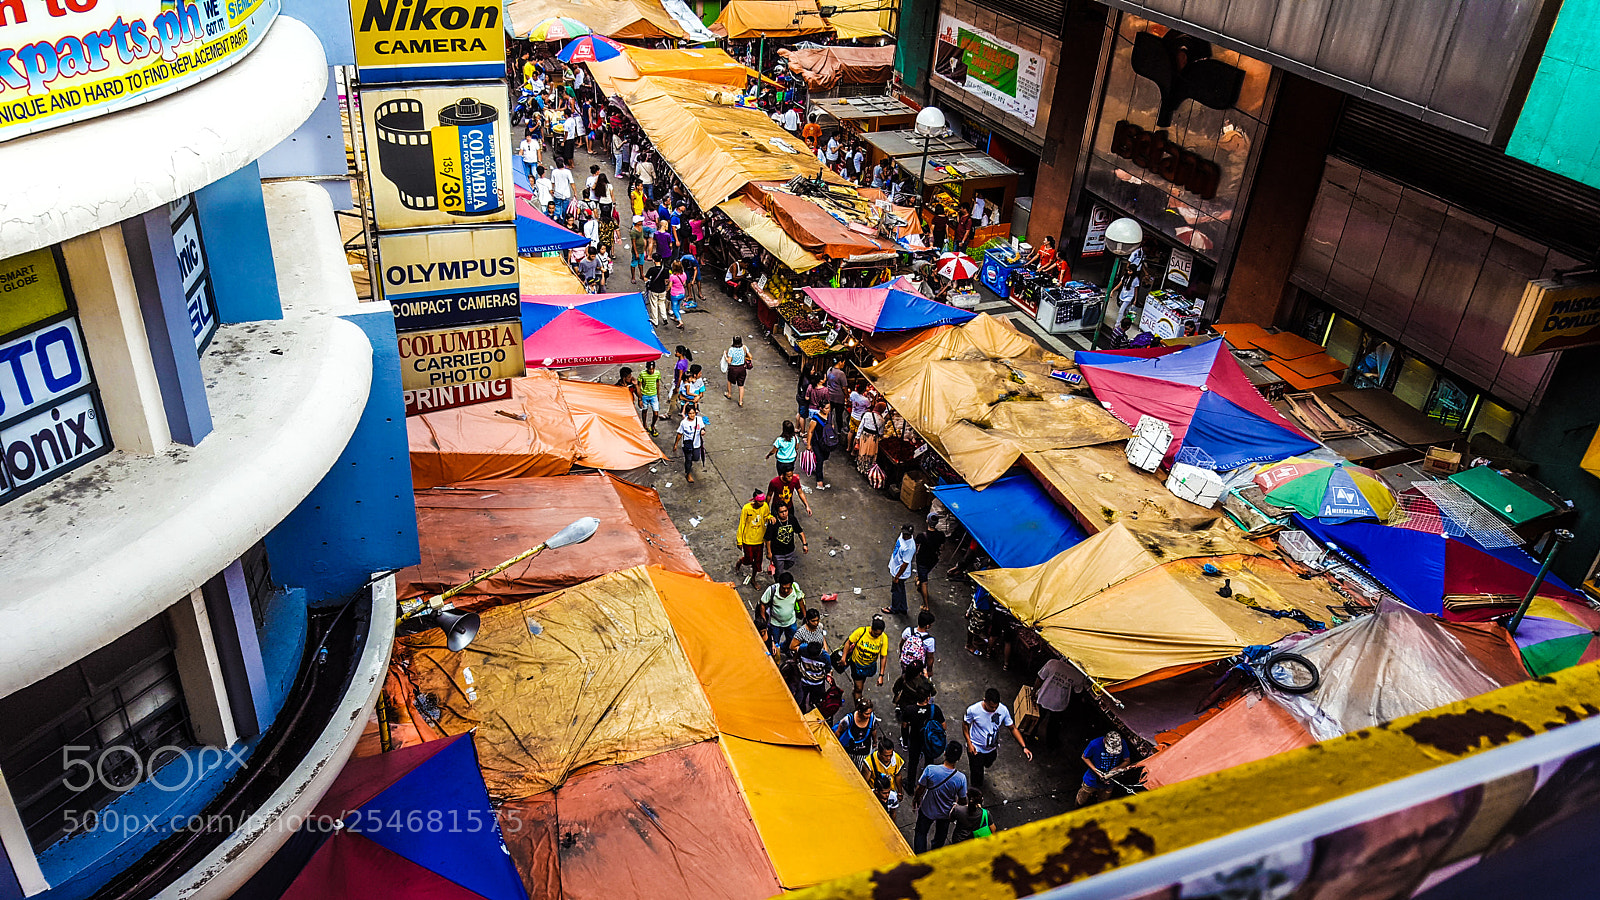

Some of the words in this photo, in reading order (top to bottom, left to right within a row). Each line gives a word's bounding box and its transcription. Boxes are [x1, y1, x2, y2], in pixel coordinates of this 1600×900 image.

[203, 0, 220, 19] WE
[359, 0, 499, 32] Nikon
[205, 20, 218, 36] GOT
[374, 37, 488, 55] CAMERA
[982, 45, 1016, 70] THEATER
[51, 89, 82, 112] AND
[83, 79, 124, 102] HARD
[125, 73, 143, 91] TO
[143, 63, 169, 85] FIND
[170, 38, 230, 75] REPLACEMENT
[230, 27, 248, 50] PARTS
[468, 129, 488, 211] COLUMBIA
[521, 244, 563, 253] MICROMATIC
[0, 265, 35, 283] SMART
[386, 256, 516, 286] OLYMPUS
[1170, 256, 1191, 273] SALE
[3, 274, 39, 293] GLOBE
[393, 298, 453, 318] COMPACT
[458, 292, 518, 312] CAMERAS
[398, 326, 518, 359] COLUMBIA
[0, 325, 83, 416] TO
[413, 349, 506, 373] CARRIEDO
[556, 355, 614, 364] MICROMATIC
[429, 366, 492, 386] PHOTO
[404, 378, 508, 413] PRINTING
[1218, 454, 1275, 470] MICROMATIC
